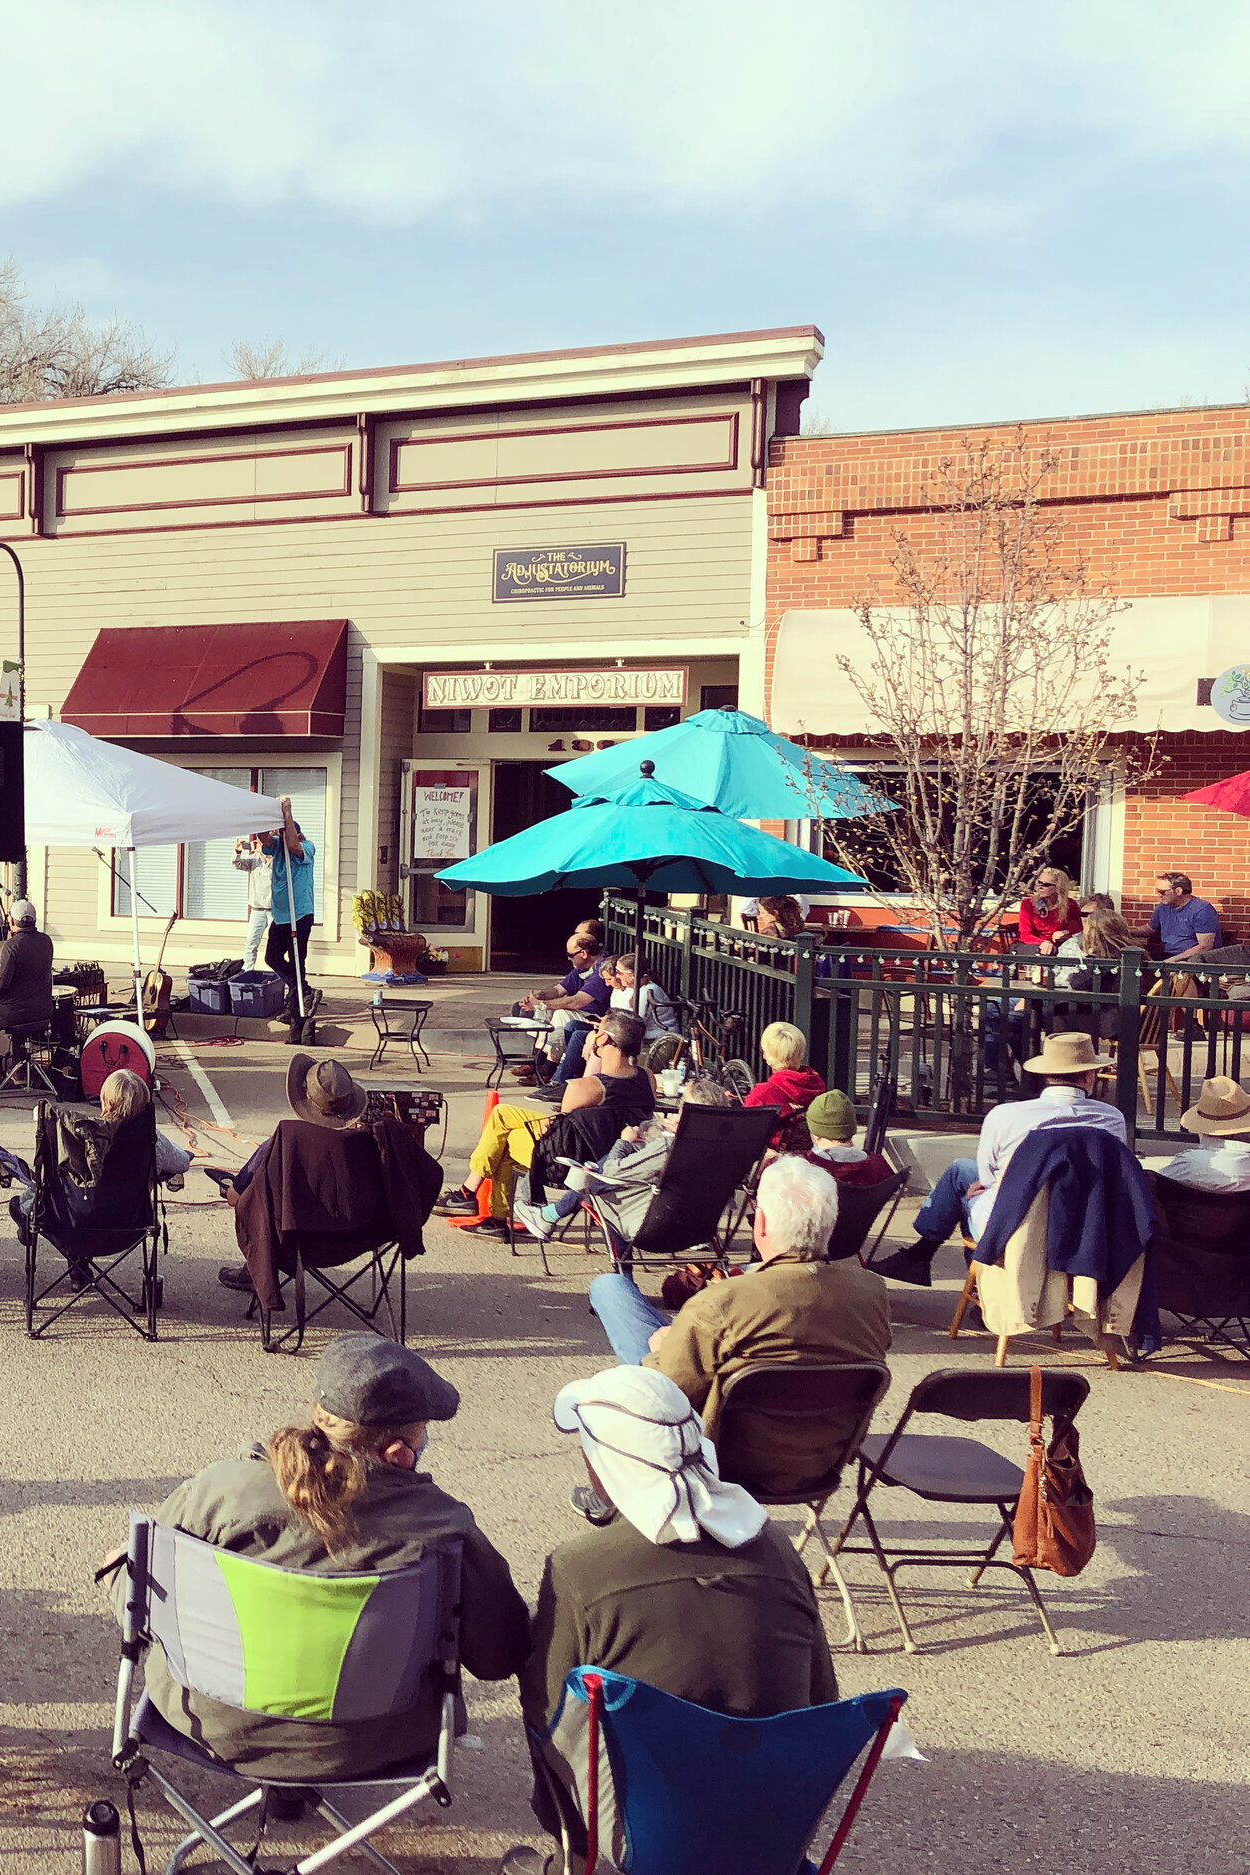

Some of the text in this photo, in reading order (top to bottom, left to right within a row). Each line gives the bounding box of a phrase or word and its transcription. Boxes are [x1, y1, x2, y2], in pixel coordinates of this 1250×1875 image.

[547, 552, 566, 562] THE
[501, 560, 616, 585] ADJUSTATORIUM
[428, 673, 681, 704] NIWOT EMPORIUM
[424, 791, 464, 803] WELCOME!
[419, 807, 430, 817] To
